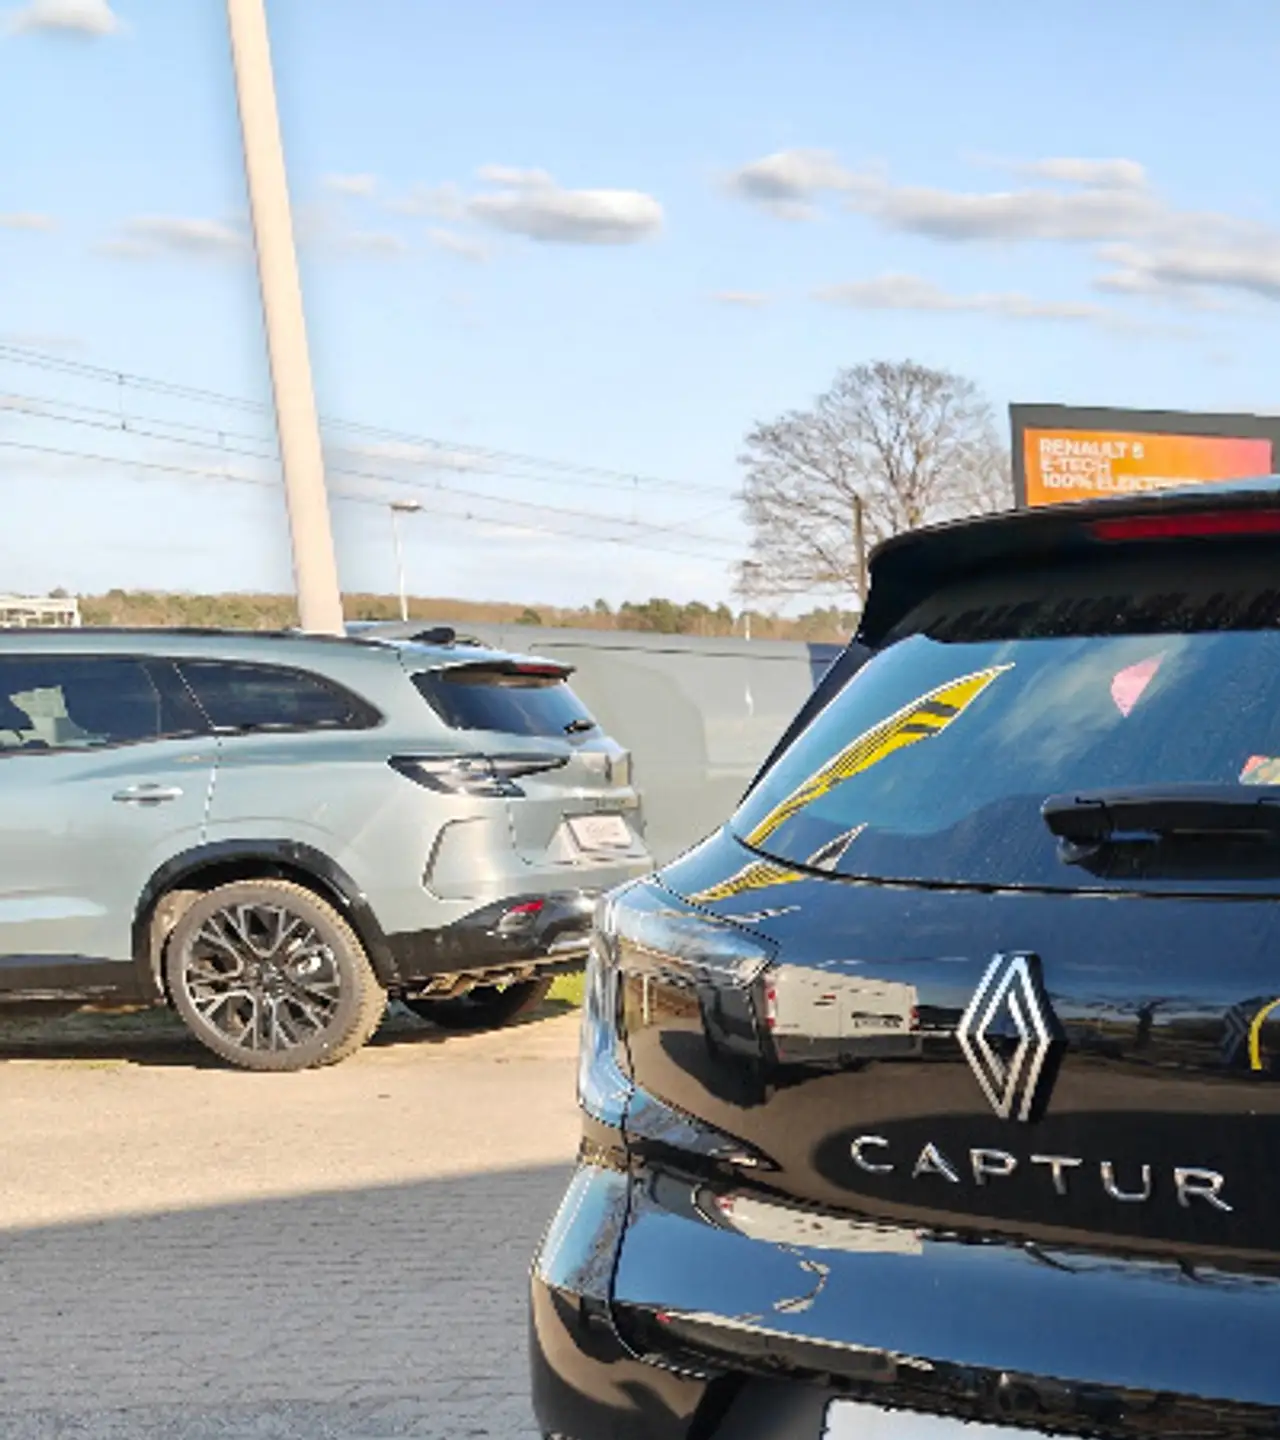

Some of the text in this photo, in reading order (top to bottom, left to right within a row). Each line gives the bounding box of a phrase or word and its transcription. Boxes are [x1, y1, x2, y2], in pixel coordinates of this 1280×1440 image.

[1040, 438, 1128, 459] RENAULT
[1043, 472, 1093, 489] 100%
[850, 1136, 1233, 1212] CAPTUR
